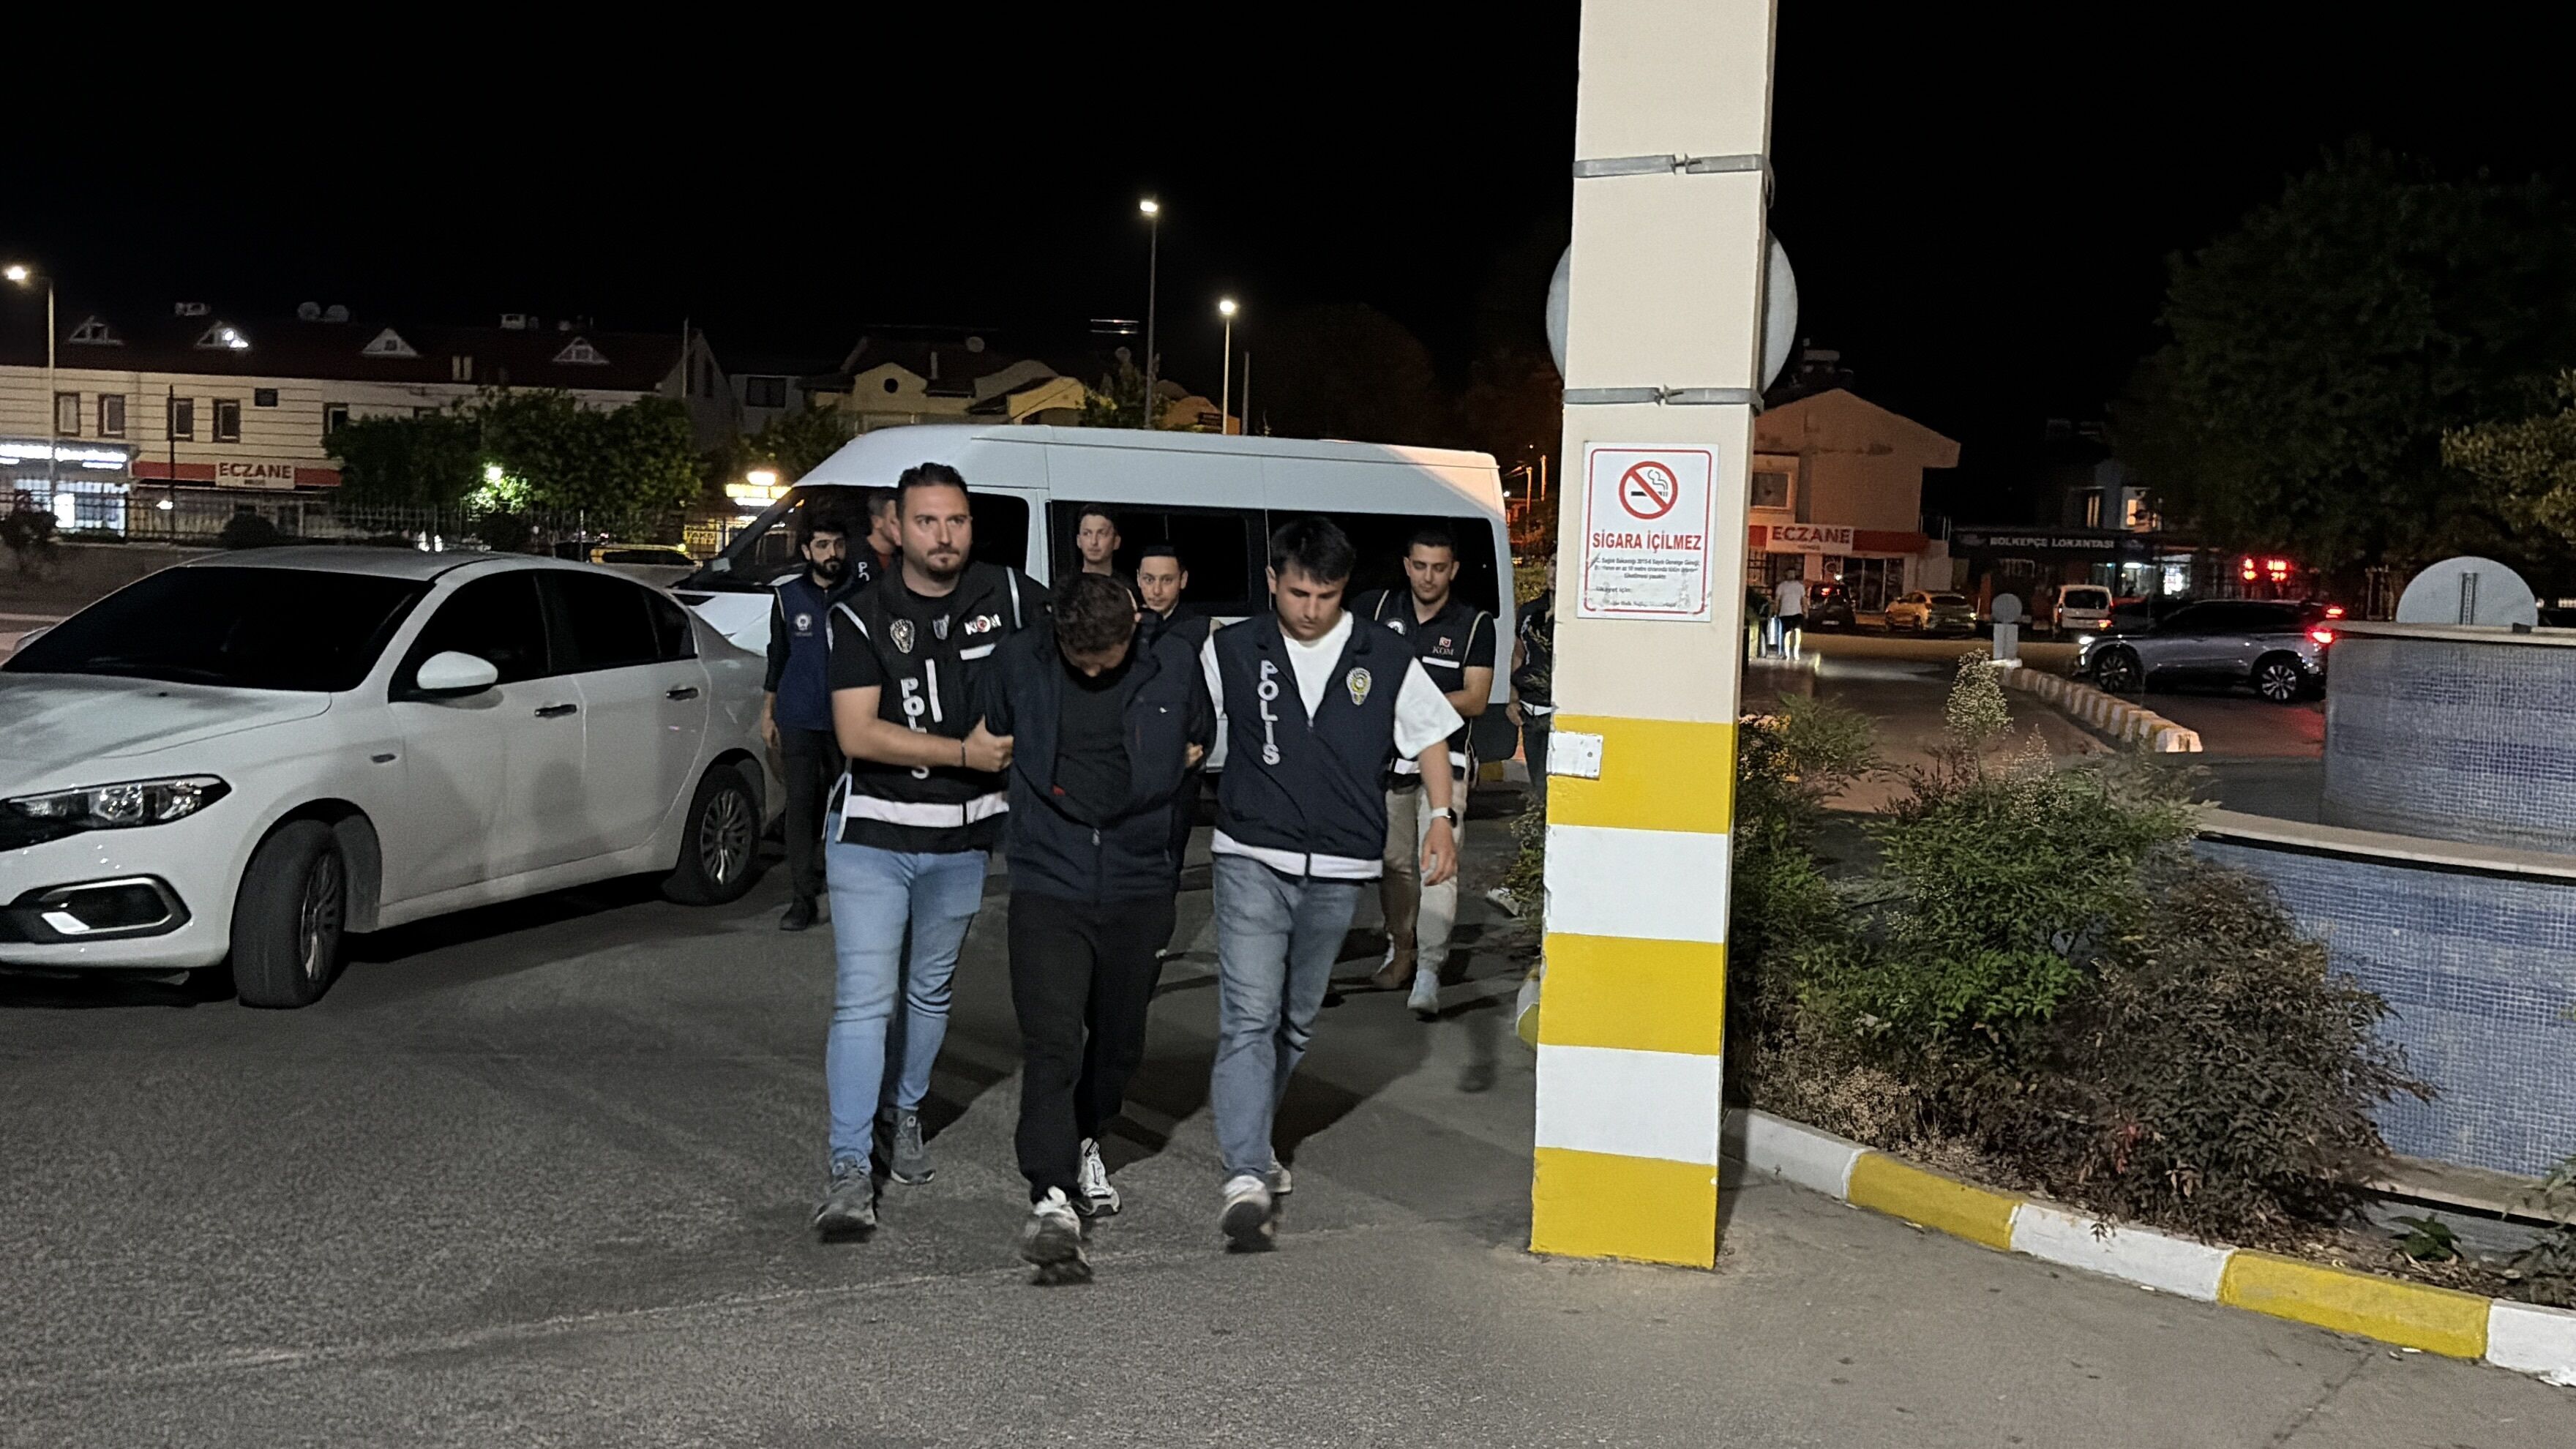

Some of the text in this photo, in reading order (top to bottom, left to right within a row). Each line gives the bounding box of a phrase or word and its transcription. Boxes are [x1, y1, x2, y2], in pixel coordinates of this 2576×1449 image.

[219, 463, 292, 479] ECZANE
[1592, 529, 1701, 553] SİGARA İÇİLMEZ
[1772, 525, 1852, 544] ECZANE
[964, 613, 1002, 636] KOM
[1432, 645, 1455, 656] KOM
